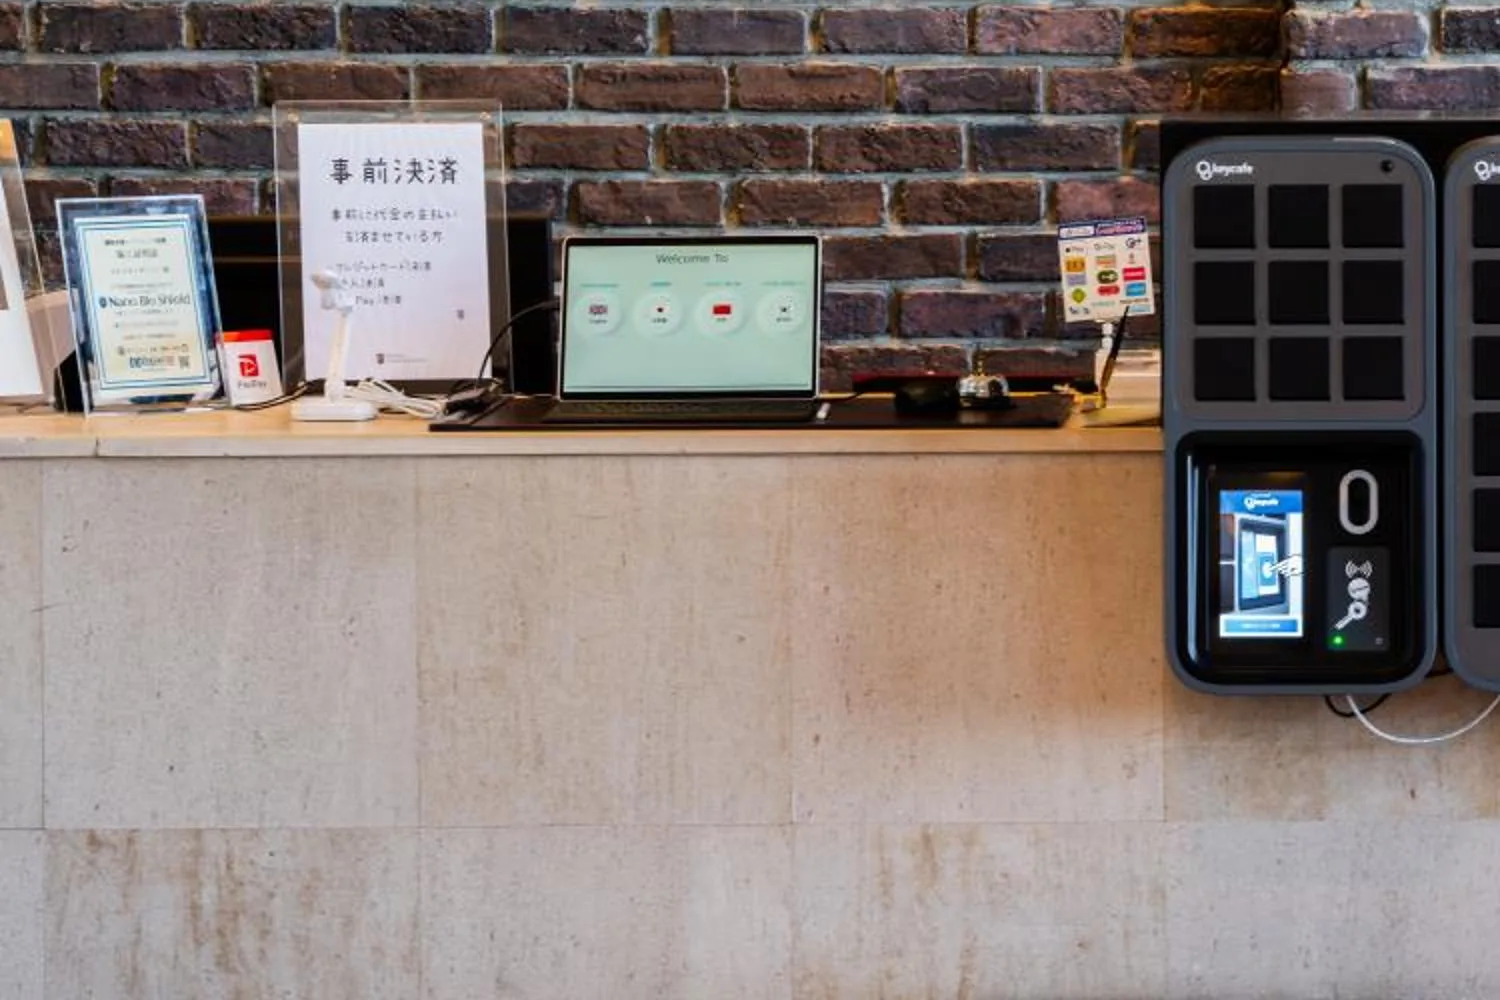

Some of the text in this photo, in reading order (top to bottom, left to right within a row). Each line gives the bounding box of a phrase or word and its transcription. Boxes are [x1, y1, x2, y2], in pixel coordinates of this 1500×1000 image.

[329, 157, 459, 185] 事前決済
[1212, 162, 1254, 177] keycafe
[655, 253, 711, 265] Welcome
